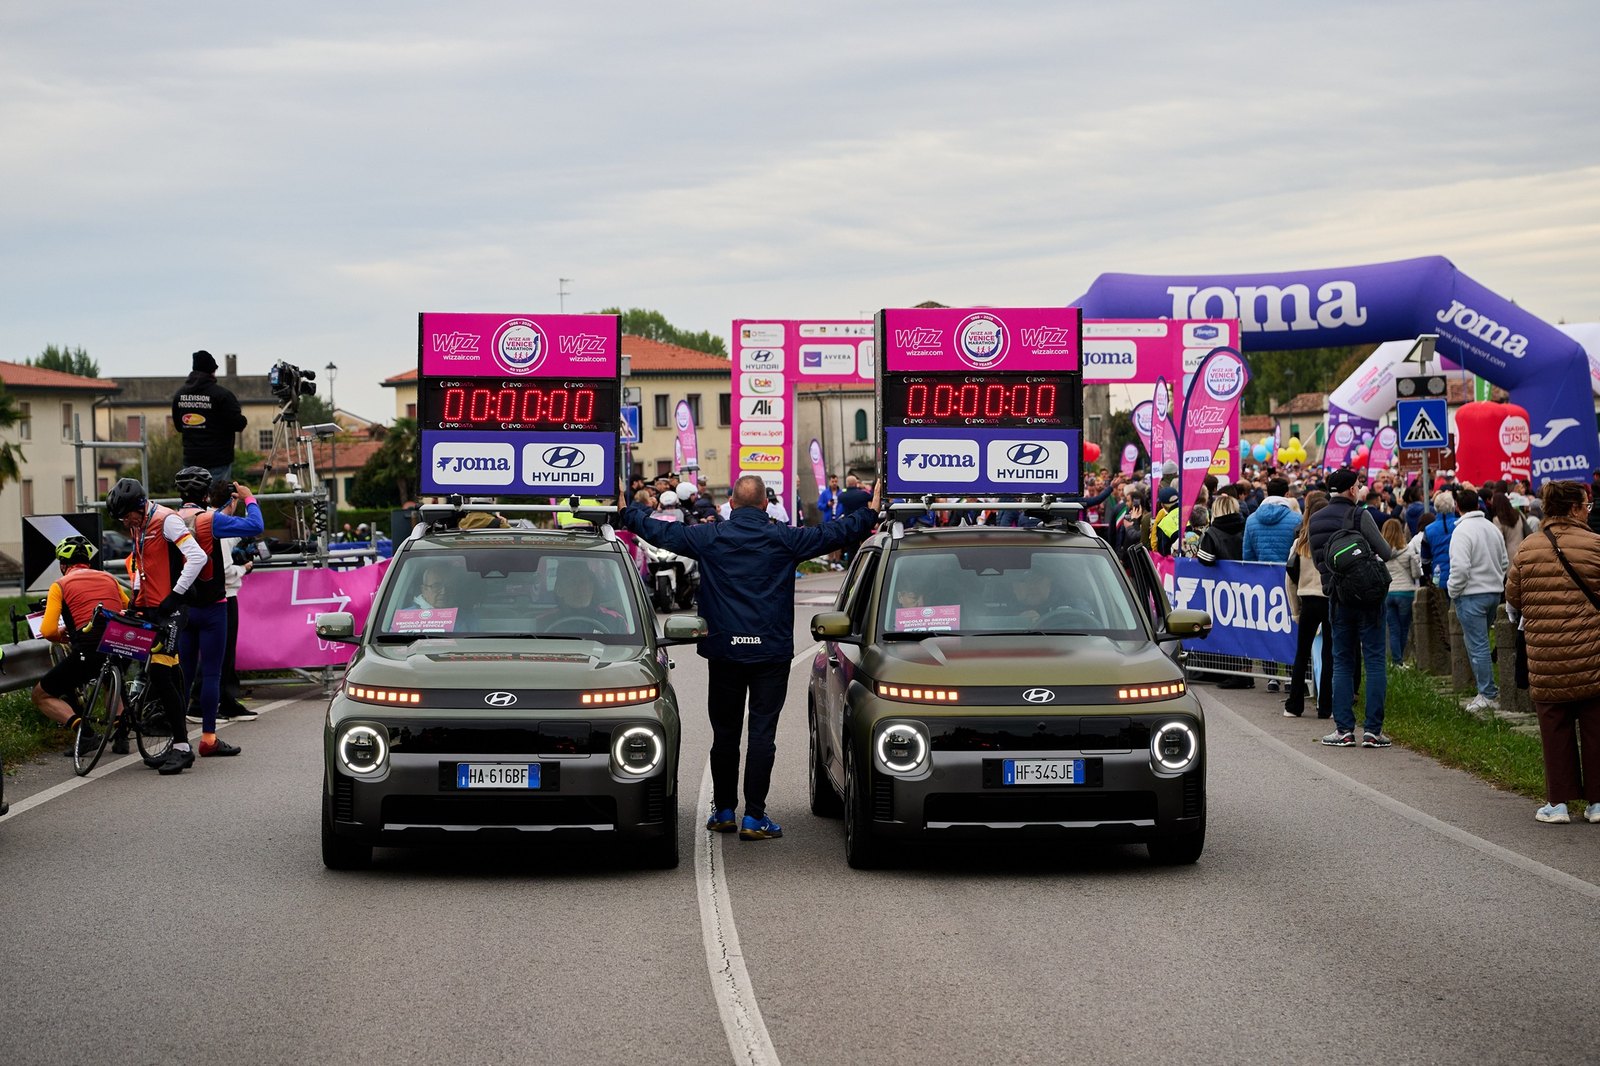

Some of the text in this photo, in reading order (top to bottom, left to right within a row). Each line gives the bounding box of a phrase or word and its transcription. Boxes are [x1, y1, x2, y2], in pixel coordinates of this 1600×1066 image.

[1435, 325, 1506, 368] www.joma-sport.com
[444, 390, 594, 422] 00:00:00
[908, 385, 1056, 416] 00:00:00
[532, 472, 593, 482] HYUNDAI
[997, 469, 1058, 479] HYUNDAI
[113, 648, 133, 656] VENEZIA
